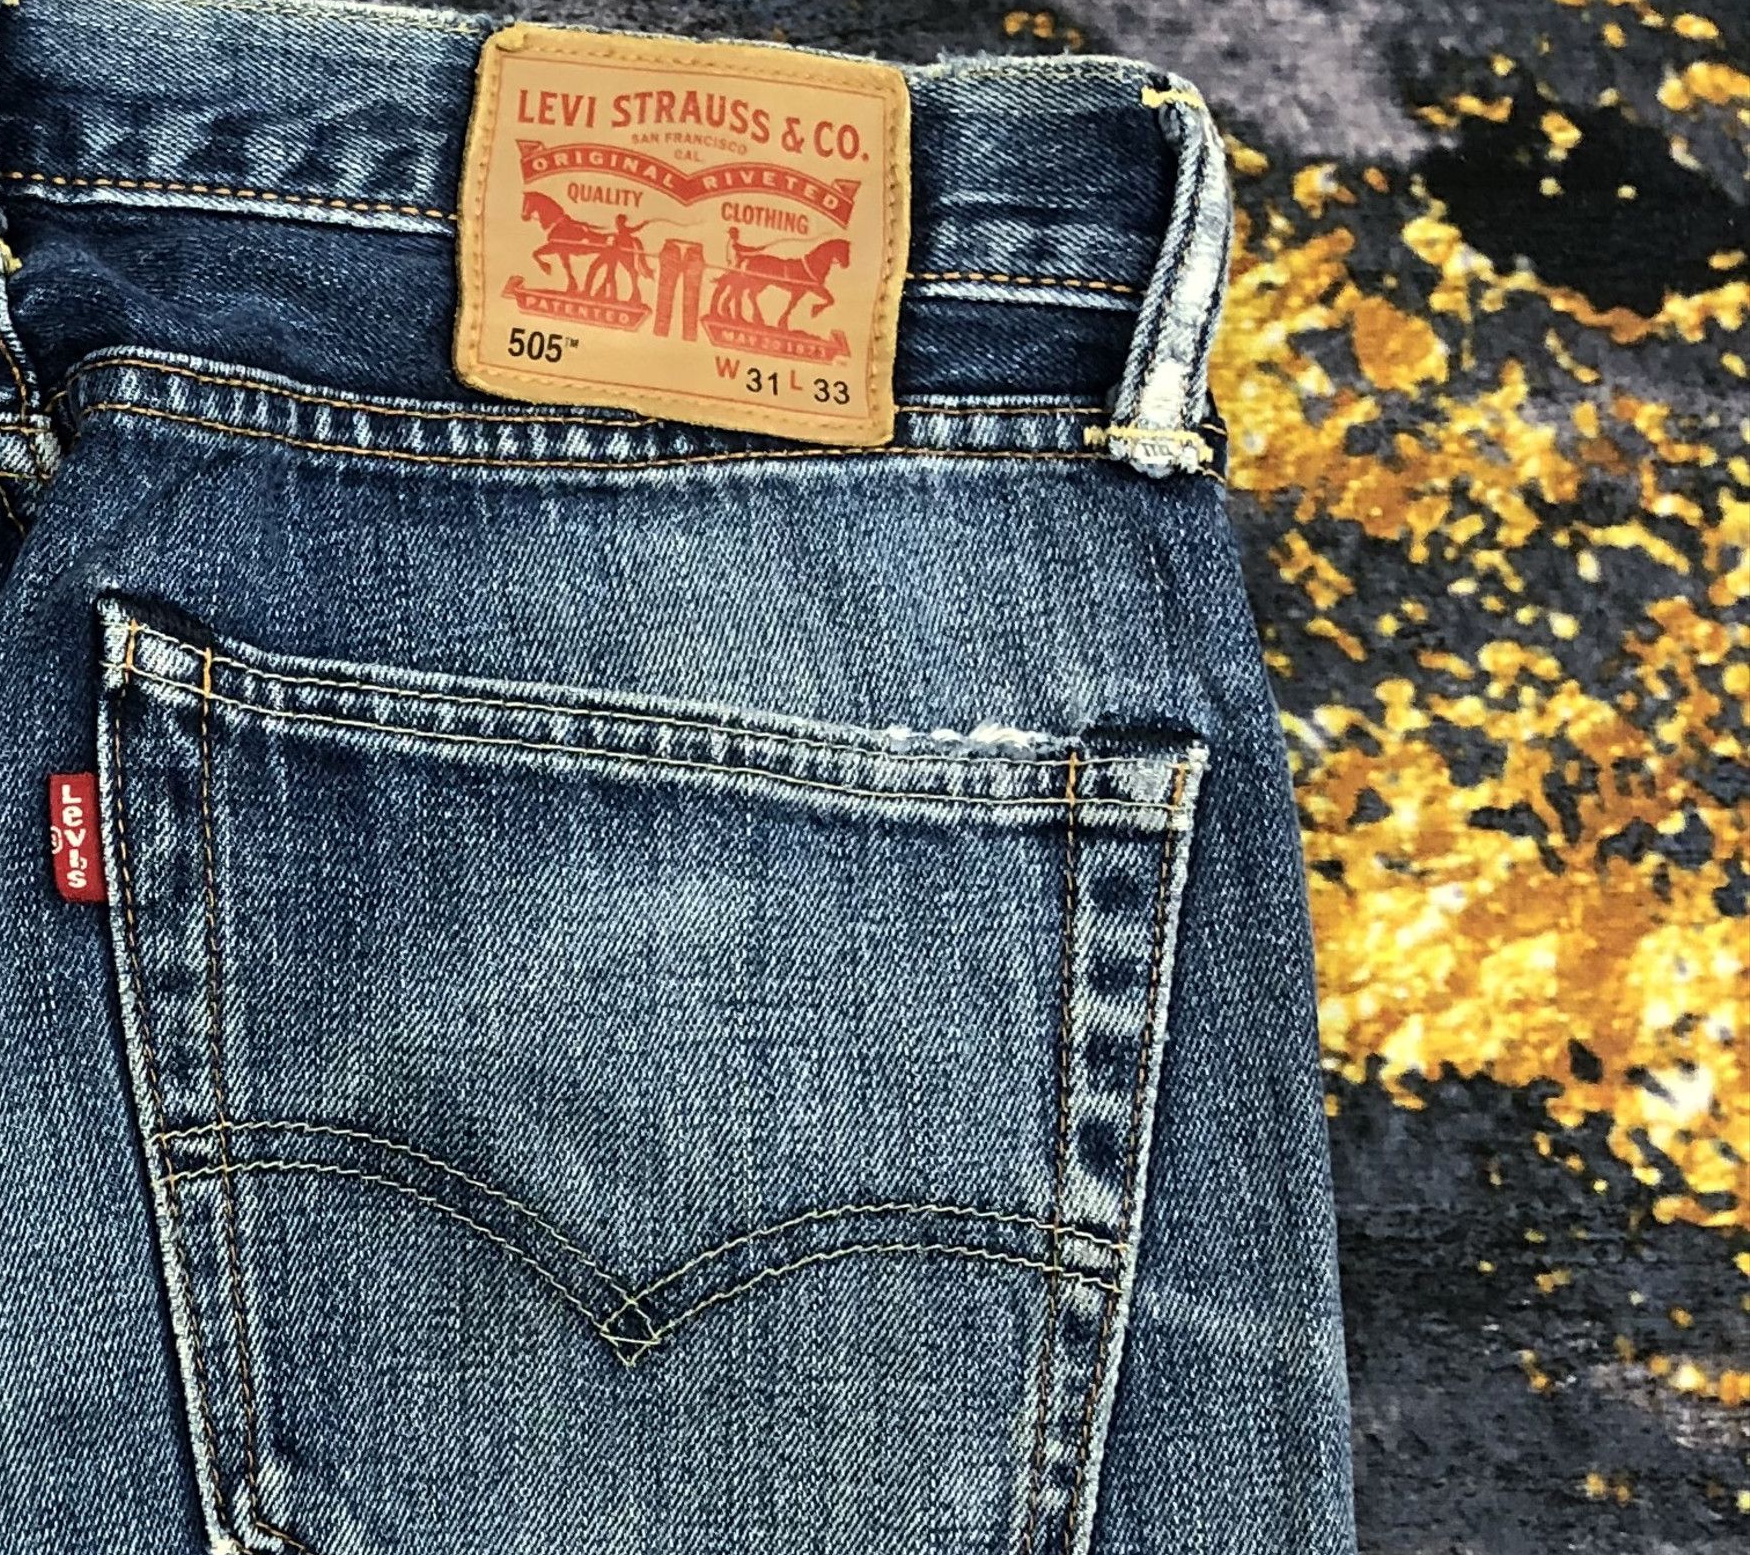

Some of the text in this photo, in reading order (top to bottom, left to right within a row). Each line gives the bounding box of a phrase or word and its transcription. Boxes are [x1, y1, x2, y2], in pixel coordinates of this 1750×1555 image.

[517, 89, 869, 162] LEVI STRAUSS & CO.
[631, 131, 748, 156] SAN FRANCISCO
[531, 150, 840, 211] ORIGINAL RIVETED
[567, 182, 809, 235] QUALITY CLOTHING
[525, 296, 631, 324] PATENTED
[714, 355, 851, 405] W 31 L 33
